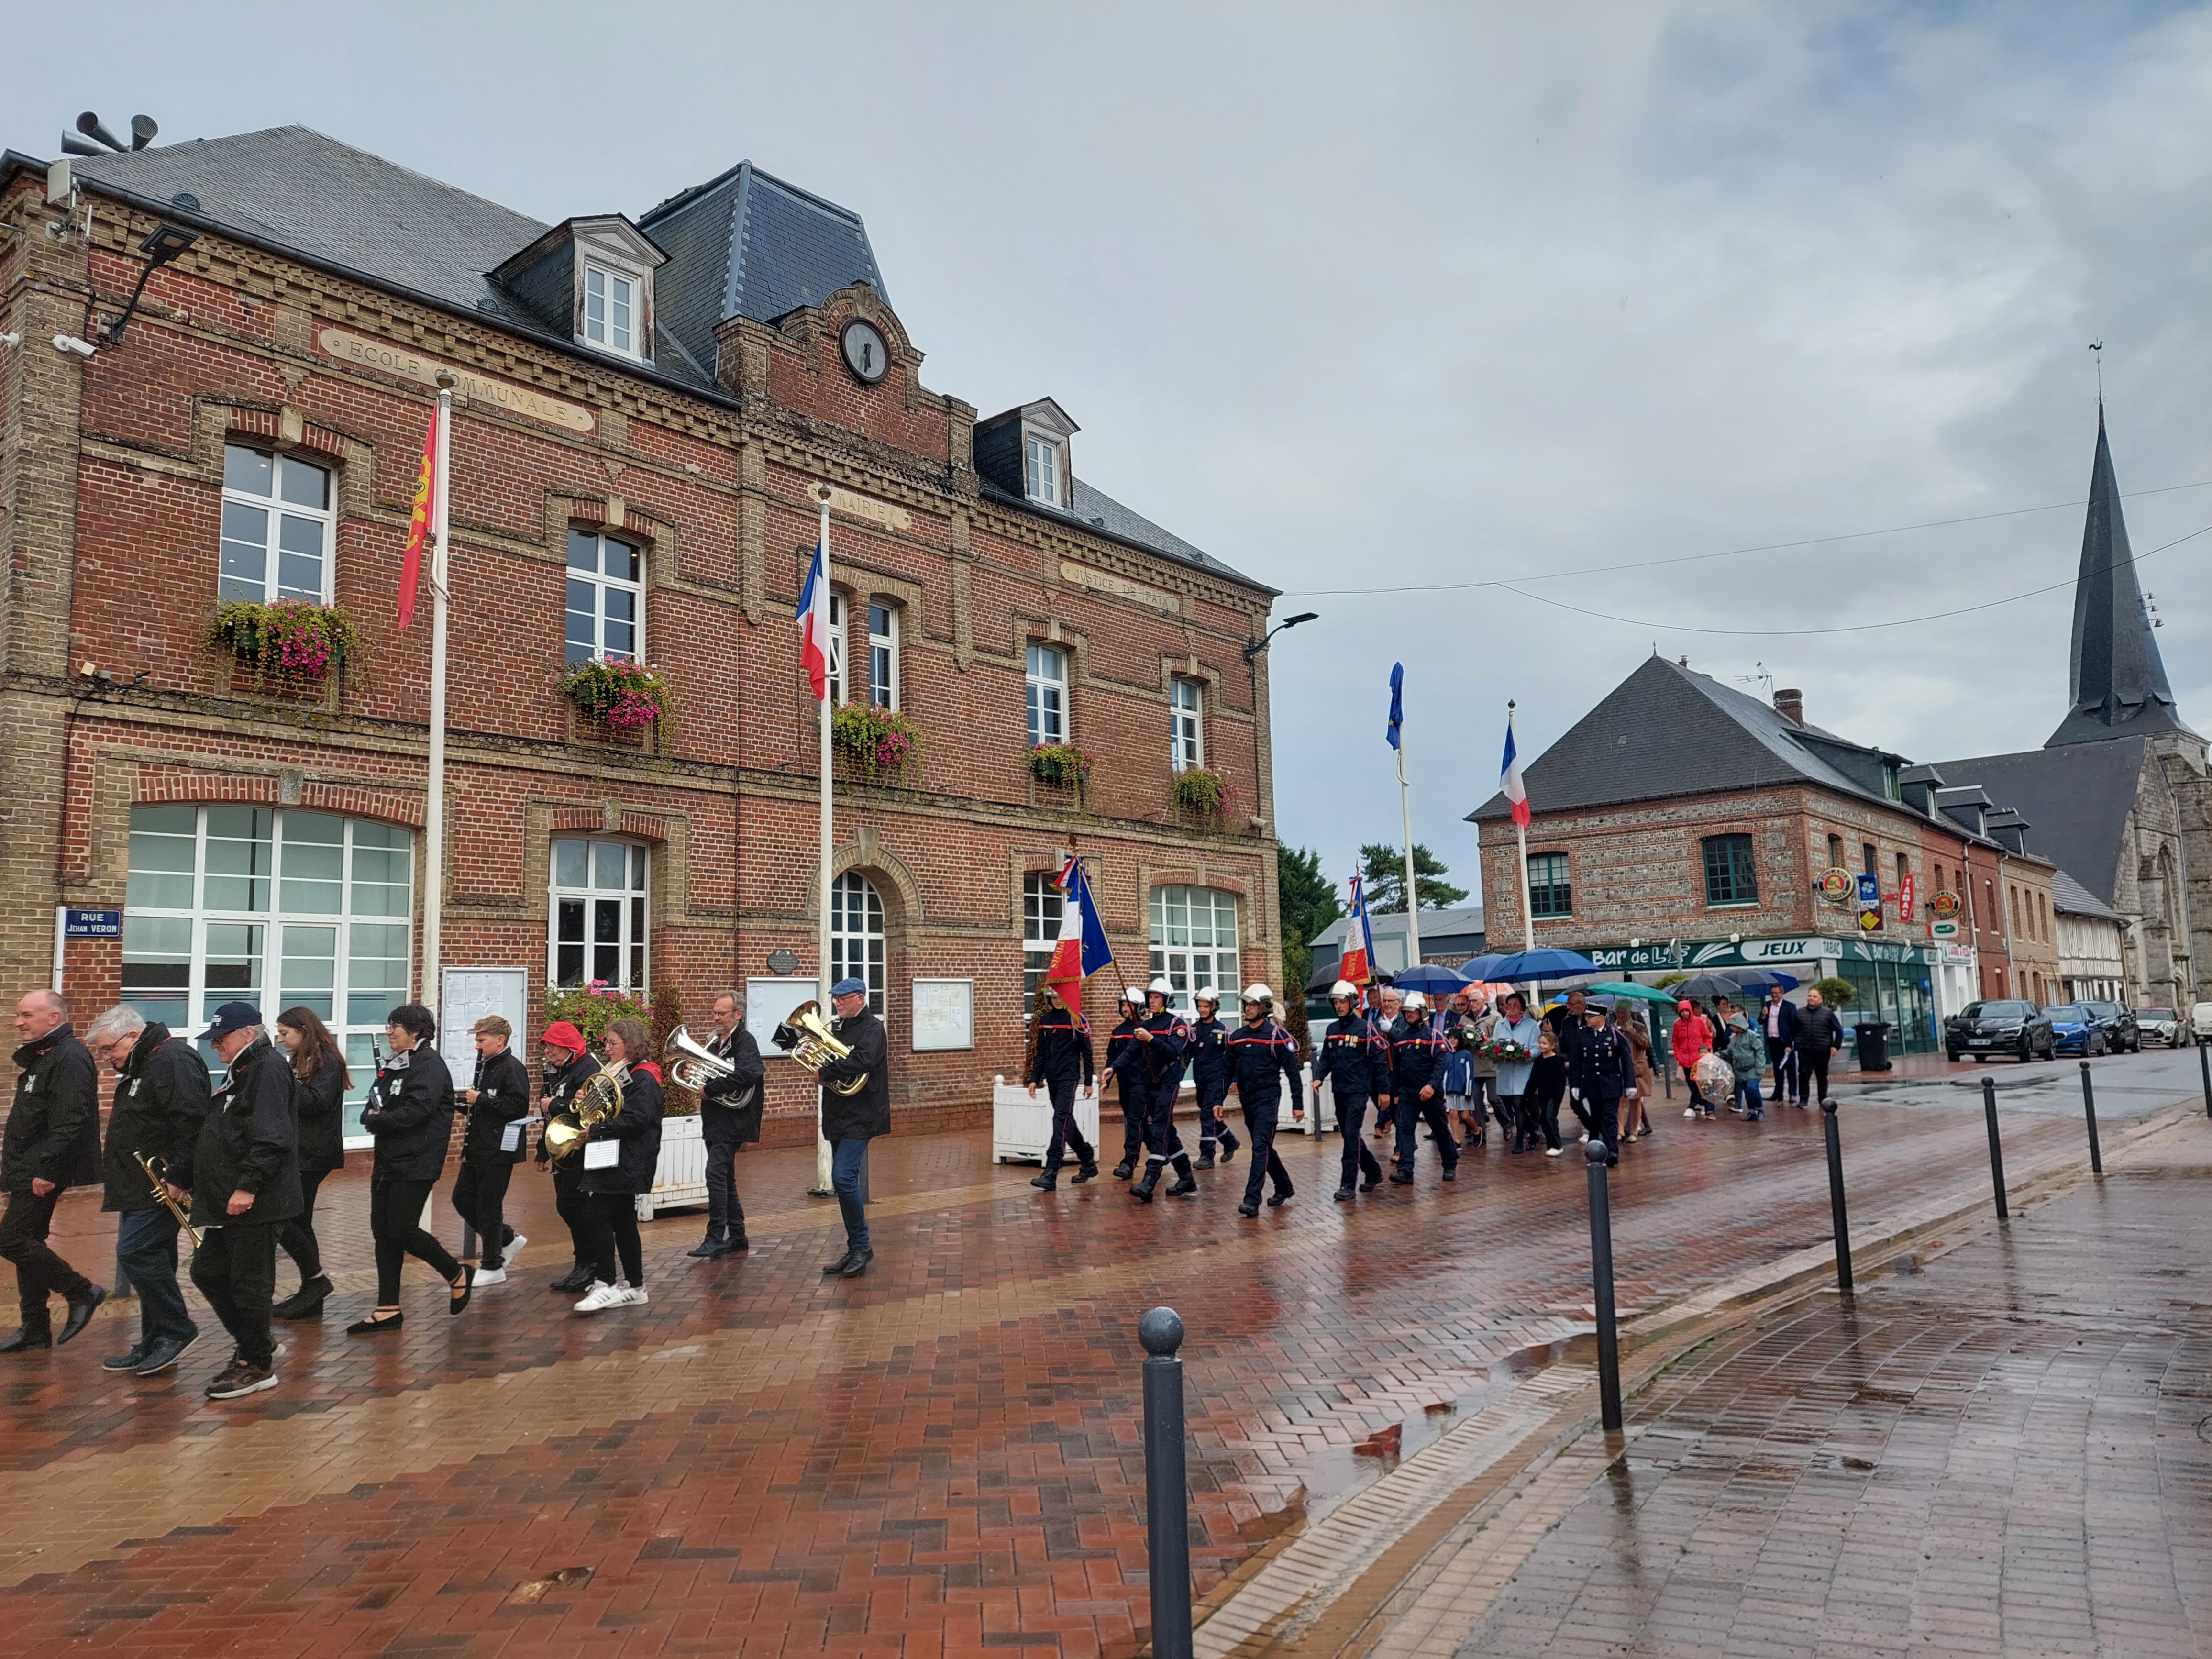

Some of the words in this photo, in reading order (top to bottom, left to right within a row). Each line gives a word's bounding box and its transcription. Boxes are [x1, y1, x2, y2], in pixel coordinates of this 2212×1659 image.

[348, 340, 420, 375] ECOLE
[836, 492, 886, 520] MAIRIE
[1074, 569, 1114, 590] JUSTICE
[1122, 583, 1137, 597] DE
[1145, 591, 1168, 607] PAIX
[1901, 878, 1911, 917] TABAC
[81, 913, 104, 921] RUE
[67, 924, 88, 932] JEHAN
[91, 925, 117, 933] VERON
[1759, 941, 1808, 956] JEUX
[1823, 940, 1840, 955] TABAC
[1592, 950, 1627, 966] Bar
[1631, 950, 1649, 964] de
